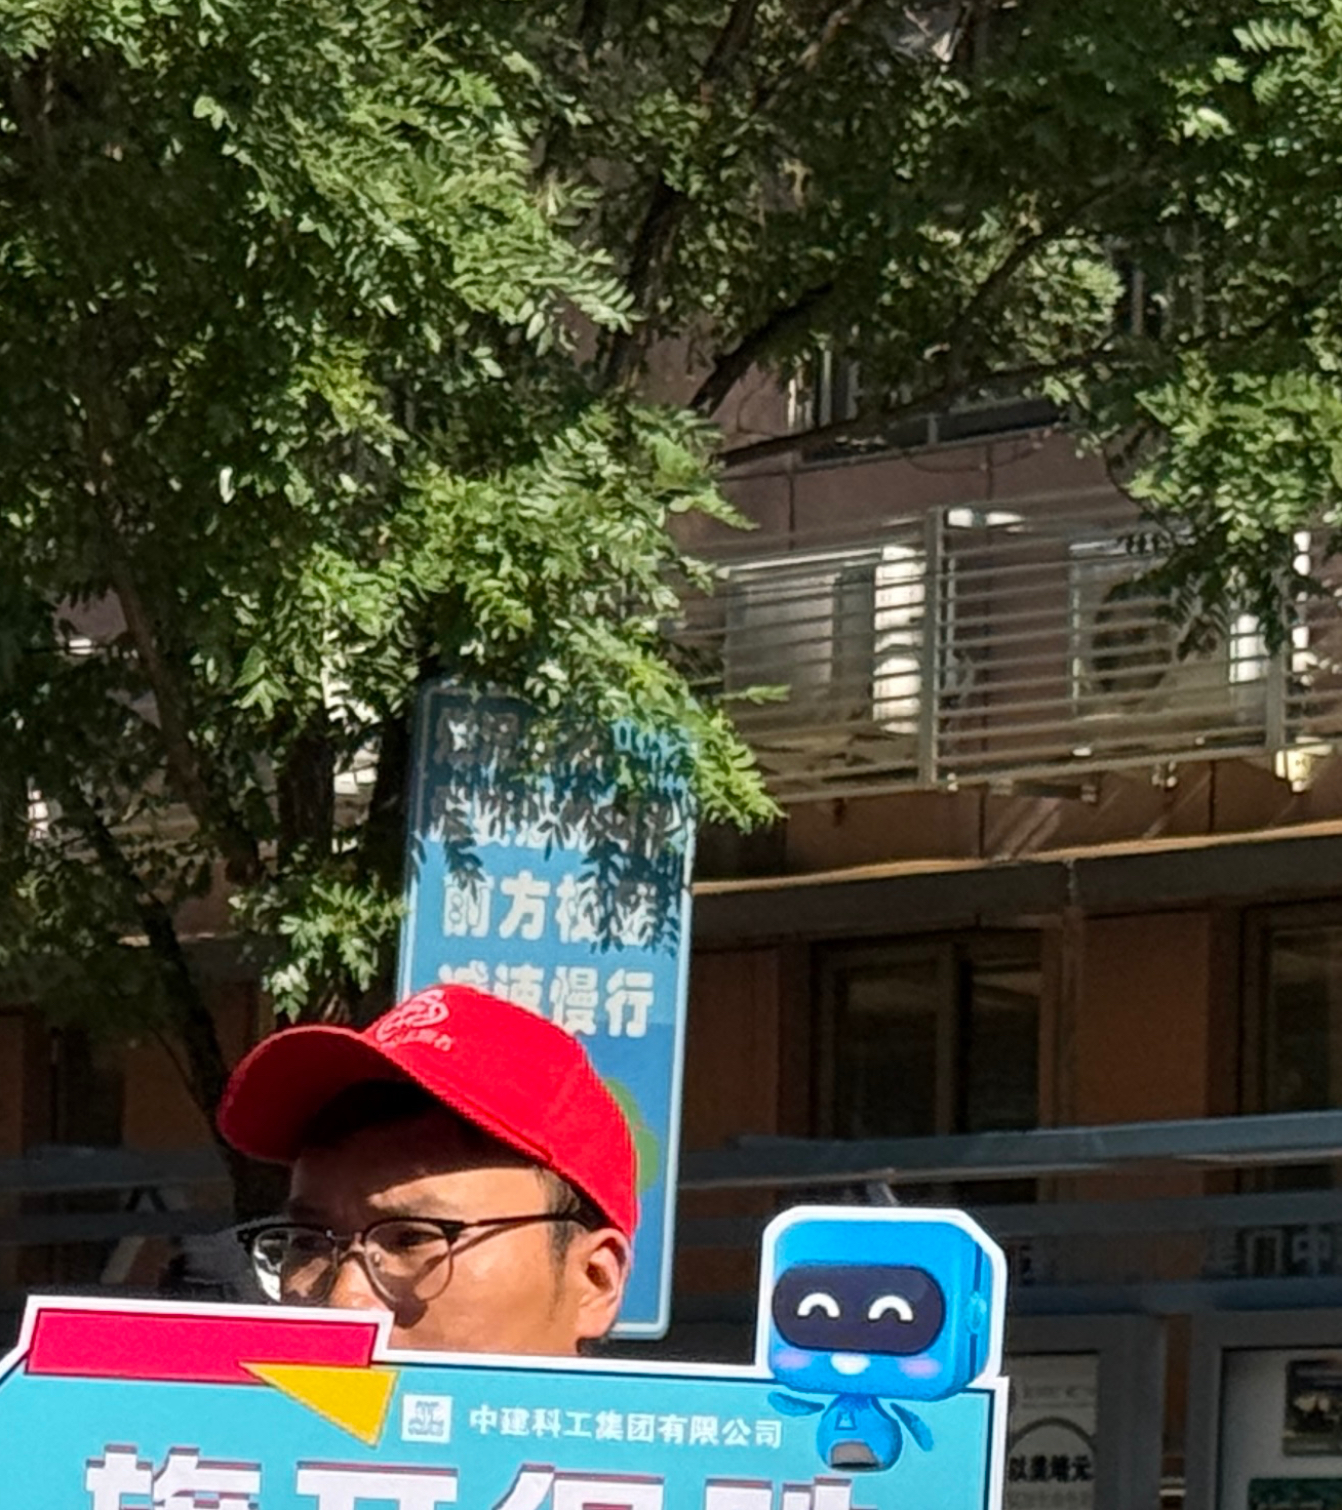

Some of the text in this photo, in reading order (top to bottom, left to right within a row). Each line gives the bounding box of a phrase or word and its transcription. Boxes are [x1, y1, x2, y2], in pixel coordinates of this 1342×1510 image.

[469, 1405, 783, 1448] 中建科工集团有限公司
